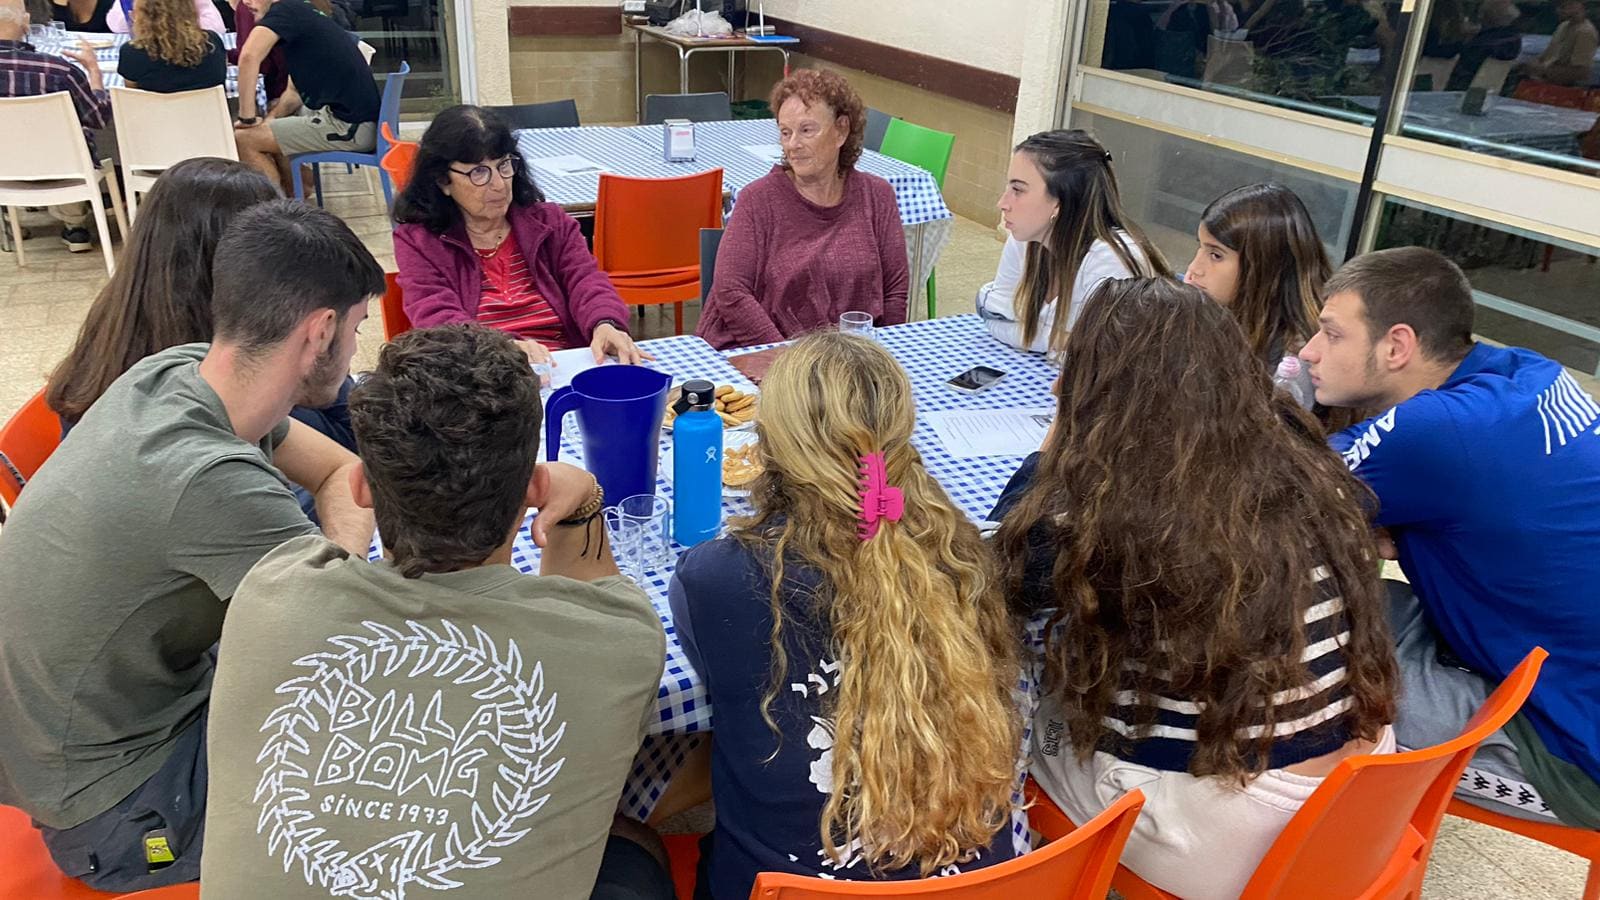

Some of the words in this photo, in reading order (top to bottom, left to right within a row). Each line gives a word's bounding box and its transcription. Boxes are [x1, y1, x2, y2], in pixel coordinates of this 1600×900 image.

[314, 733, 488, 798] BONG
[320, 794, 392, 819] SINCE
[398, 803, 449, 825] 1973
